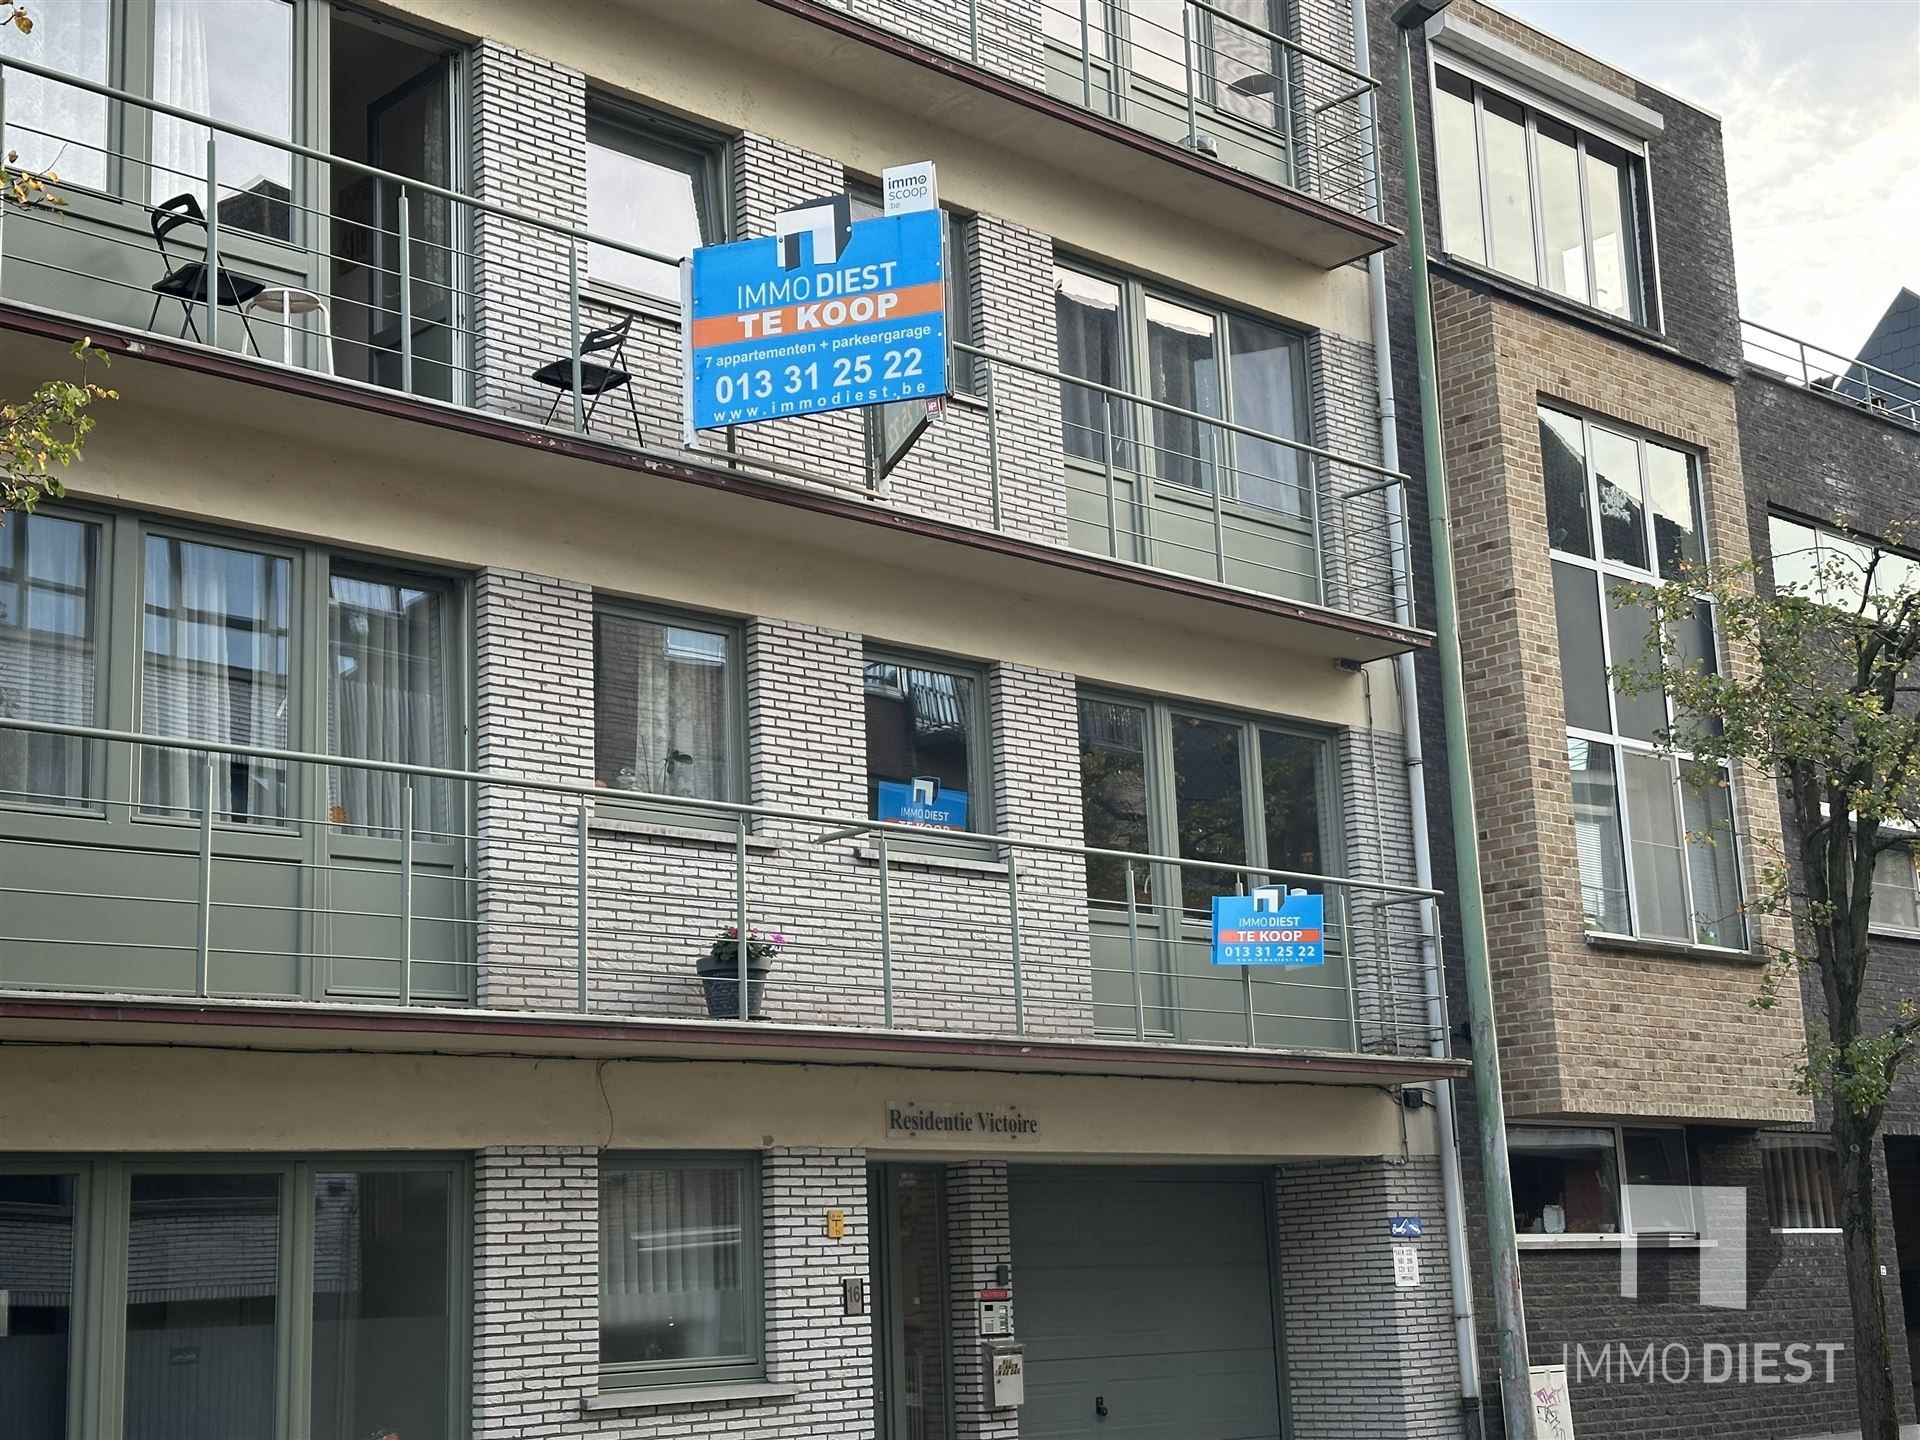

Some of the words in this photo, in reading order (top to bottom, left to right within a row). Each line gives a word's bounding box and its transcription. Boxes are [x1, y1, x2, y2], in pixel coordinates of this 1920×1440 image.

[888, 186, 928, 200] scoop
[738, 276, 810, 309] IMMO
[816, 261, 897, 298] DIEST
[737, 310, 783, 338] TE
[796, 293, 898, 331] KOOP
[704, 356, 712, 368] 7
[716, 341, 816, 368] appartementen
[832, 324, 932, 352] parkeergarage
[715, 369, 772, 404] 013
[784, 362, 818, 394] 31
[832, 354, 872, 388] 25
[882, 348, 922, 380] 22
[714, 382, 926, 422] www.immodiest.be
[924, 809, 950, 821] DIEST
[1268, 916, 1300, 927] DIEST
[1237, 930, 1256, 942] TE
[1260, 930, 1302, 942] KOOP
[1225, 946, 1250, 957] 013
[1255, 946, 1270, 957] 31
[1276, 946, 1294, 957] 25
[1298, 946, 1315, 957] 22
[889, 1109, 973, 1132] Residentie
[976, 1112, 1038, 1134] Victoire
[848, 1286, 860, 1303] 16
